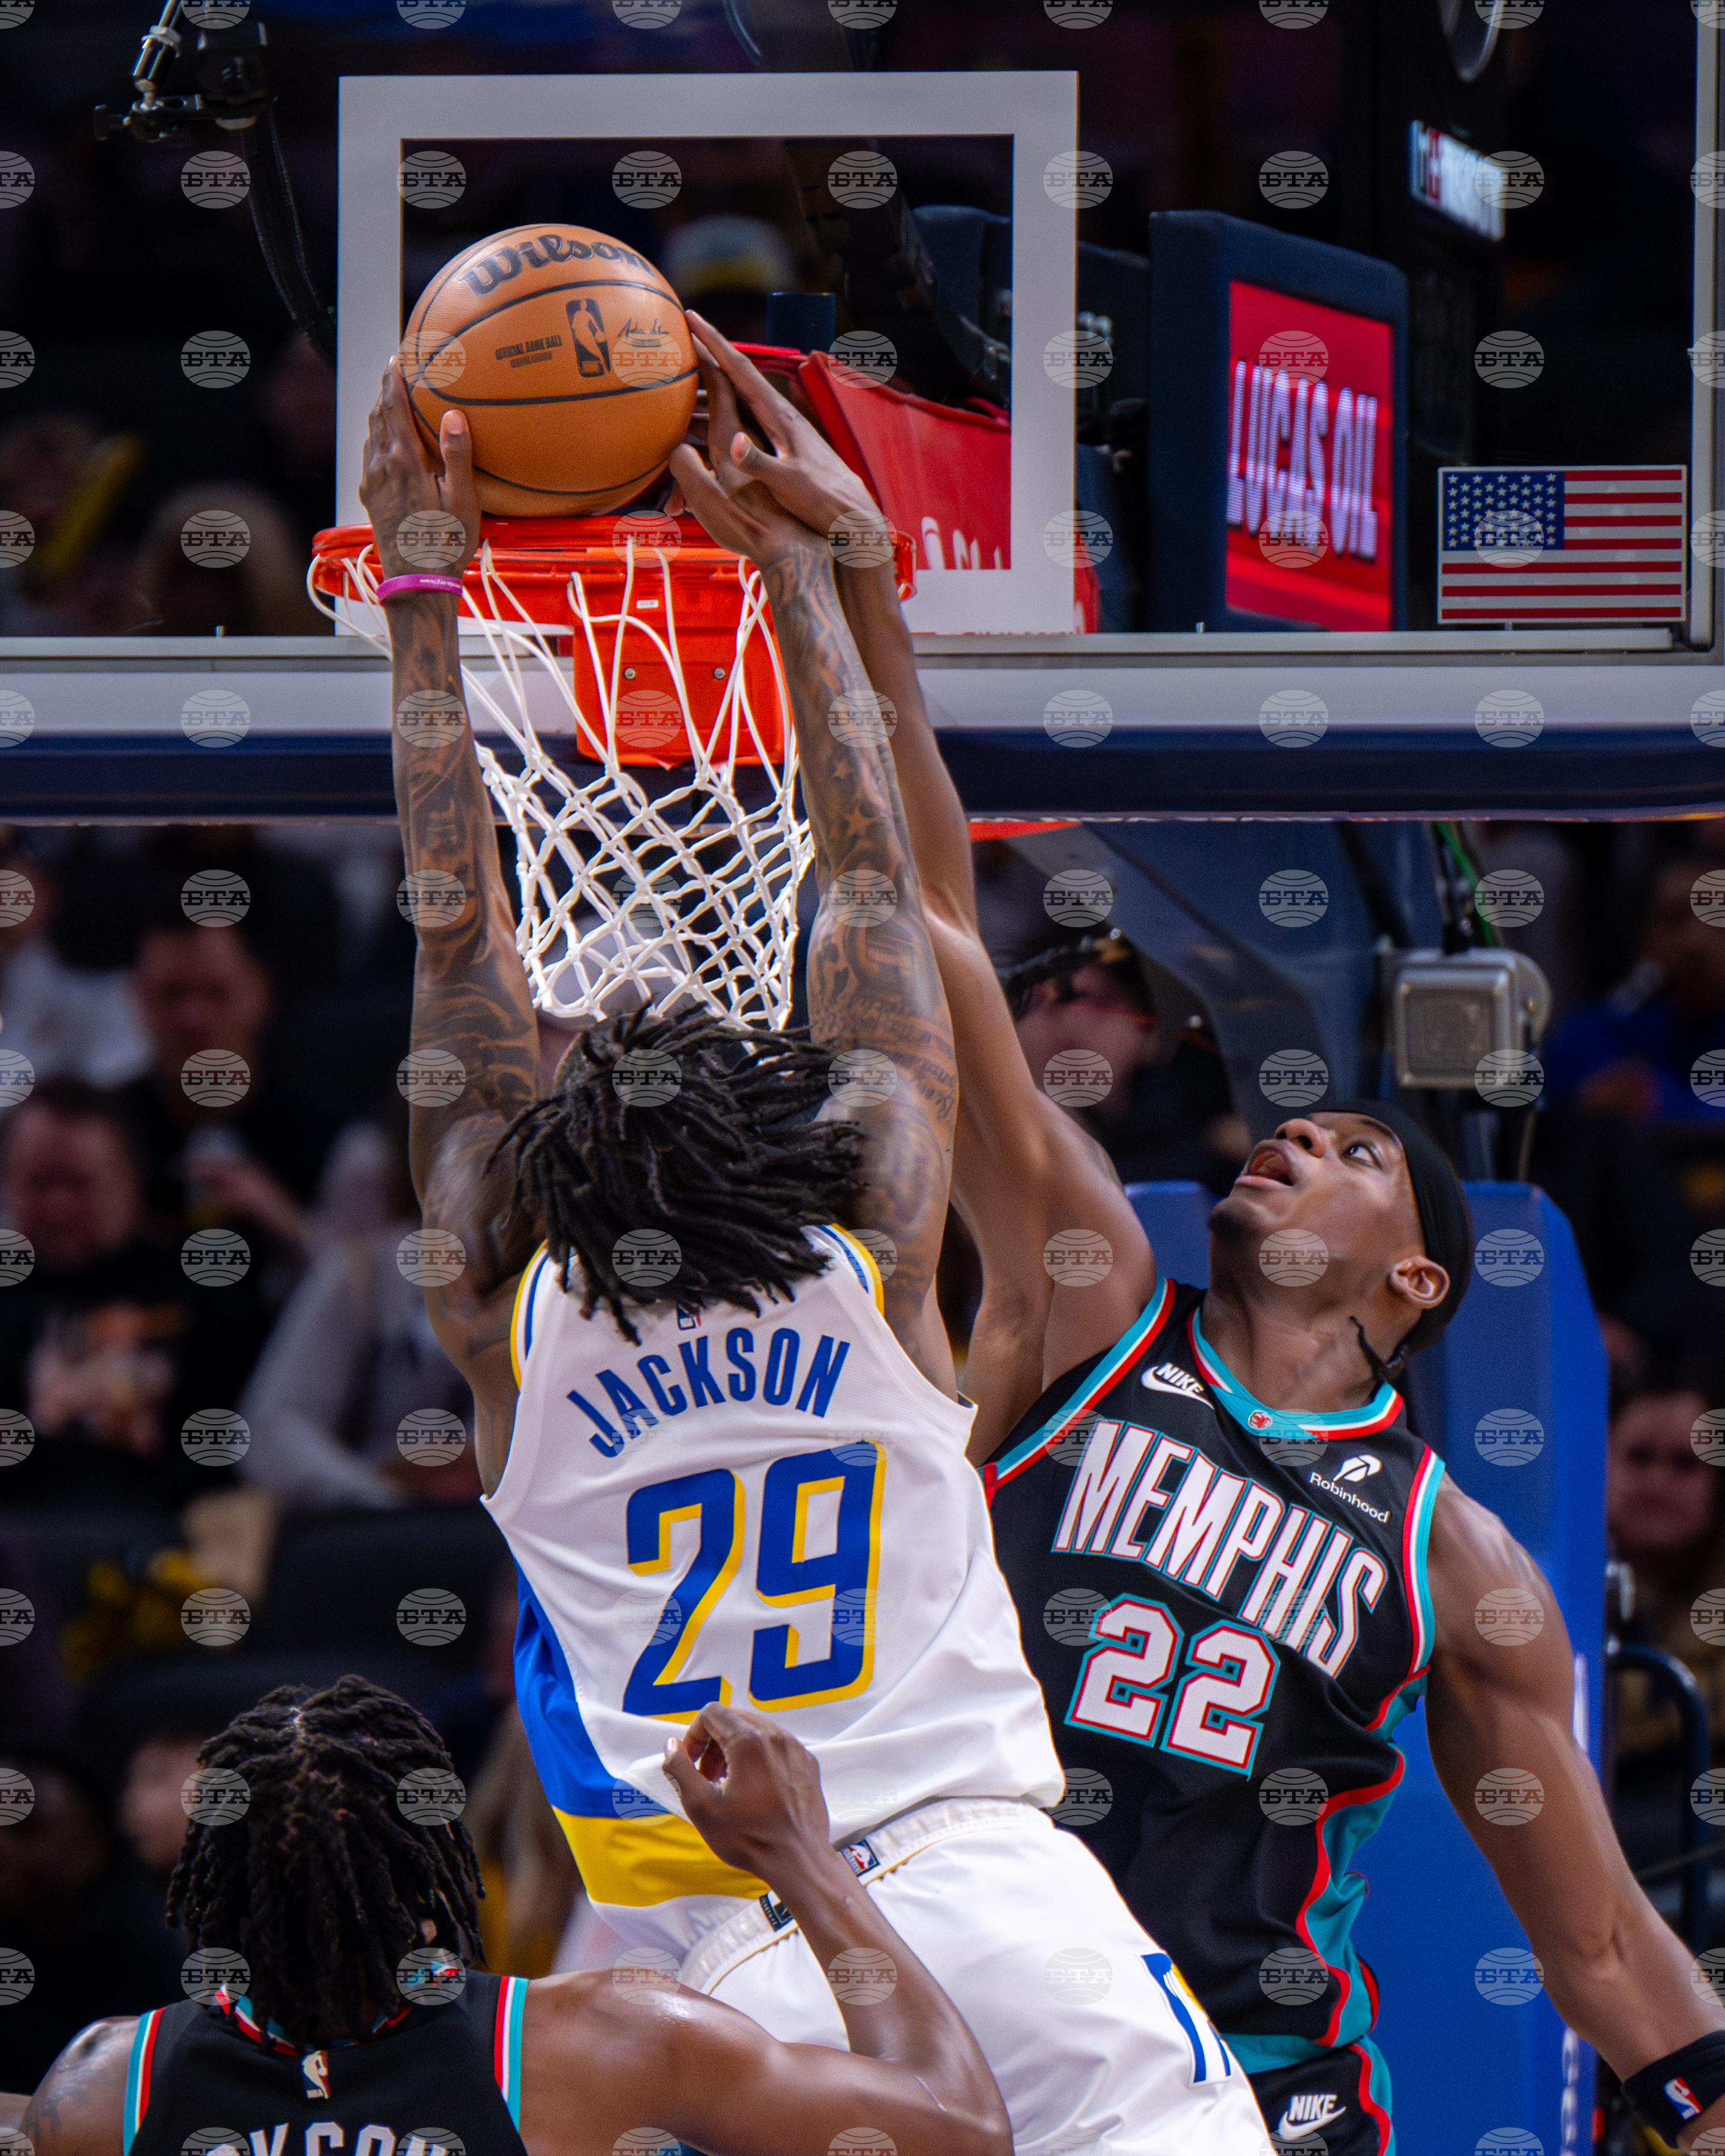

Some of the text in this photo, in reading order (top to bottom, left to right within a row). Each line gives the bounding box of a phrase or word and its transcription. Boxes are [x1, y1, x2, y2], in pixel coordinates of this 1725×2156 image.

[459, 234, 655, 296] Wilson
[1226, 359, 1329, 552] LUCAS
[567, 1328, 850, 1457] JACKSON
[1155, 1362, 1205, 1393] NIKE
[1051, 1418, 1387, 1678] MEMPHIS
[1309, 1471, 1390, 1524] Robinhood
[623, 1440, 886, 1724] 29
[1065, 1593, 1281, 1776] 22
[1288, 2094, 1337, 2121] NIKE
